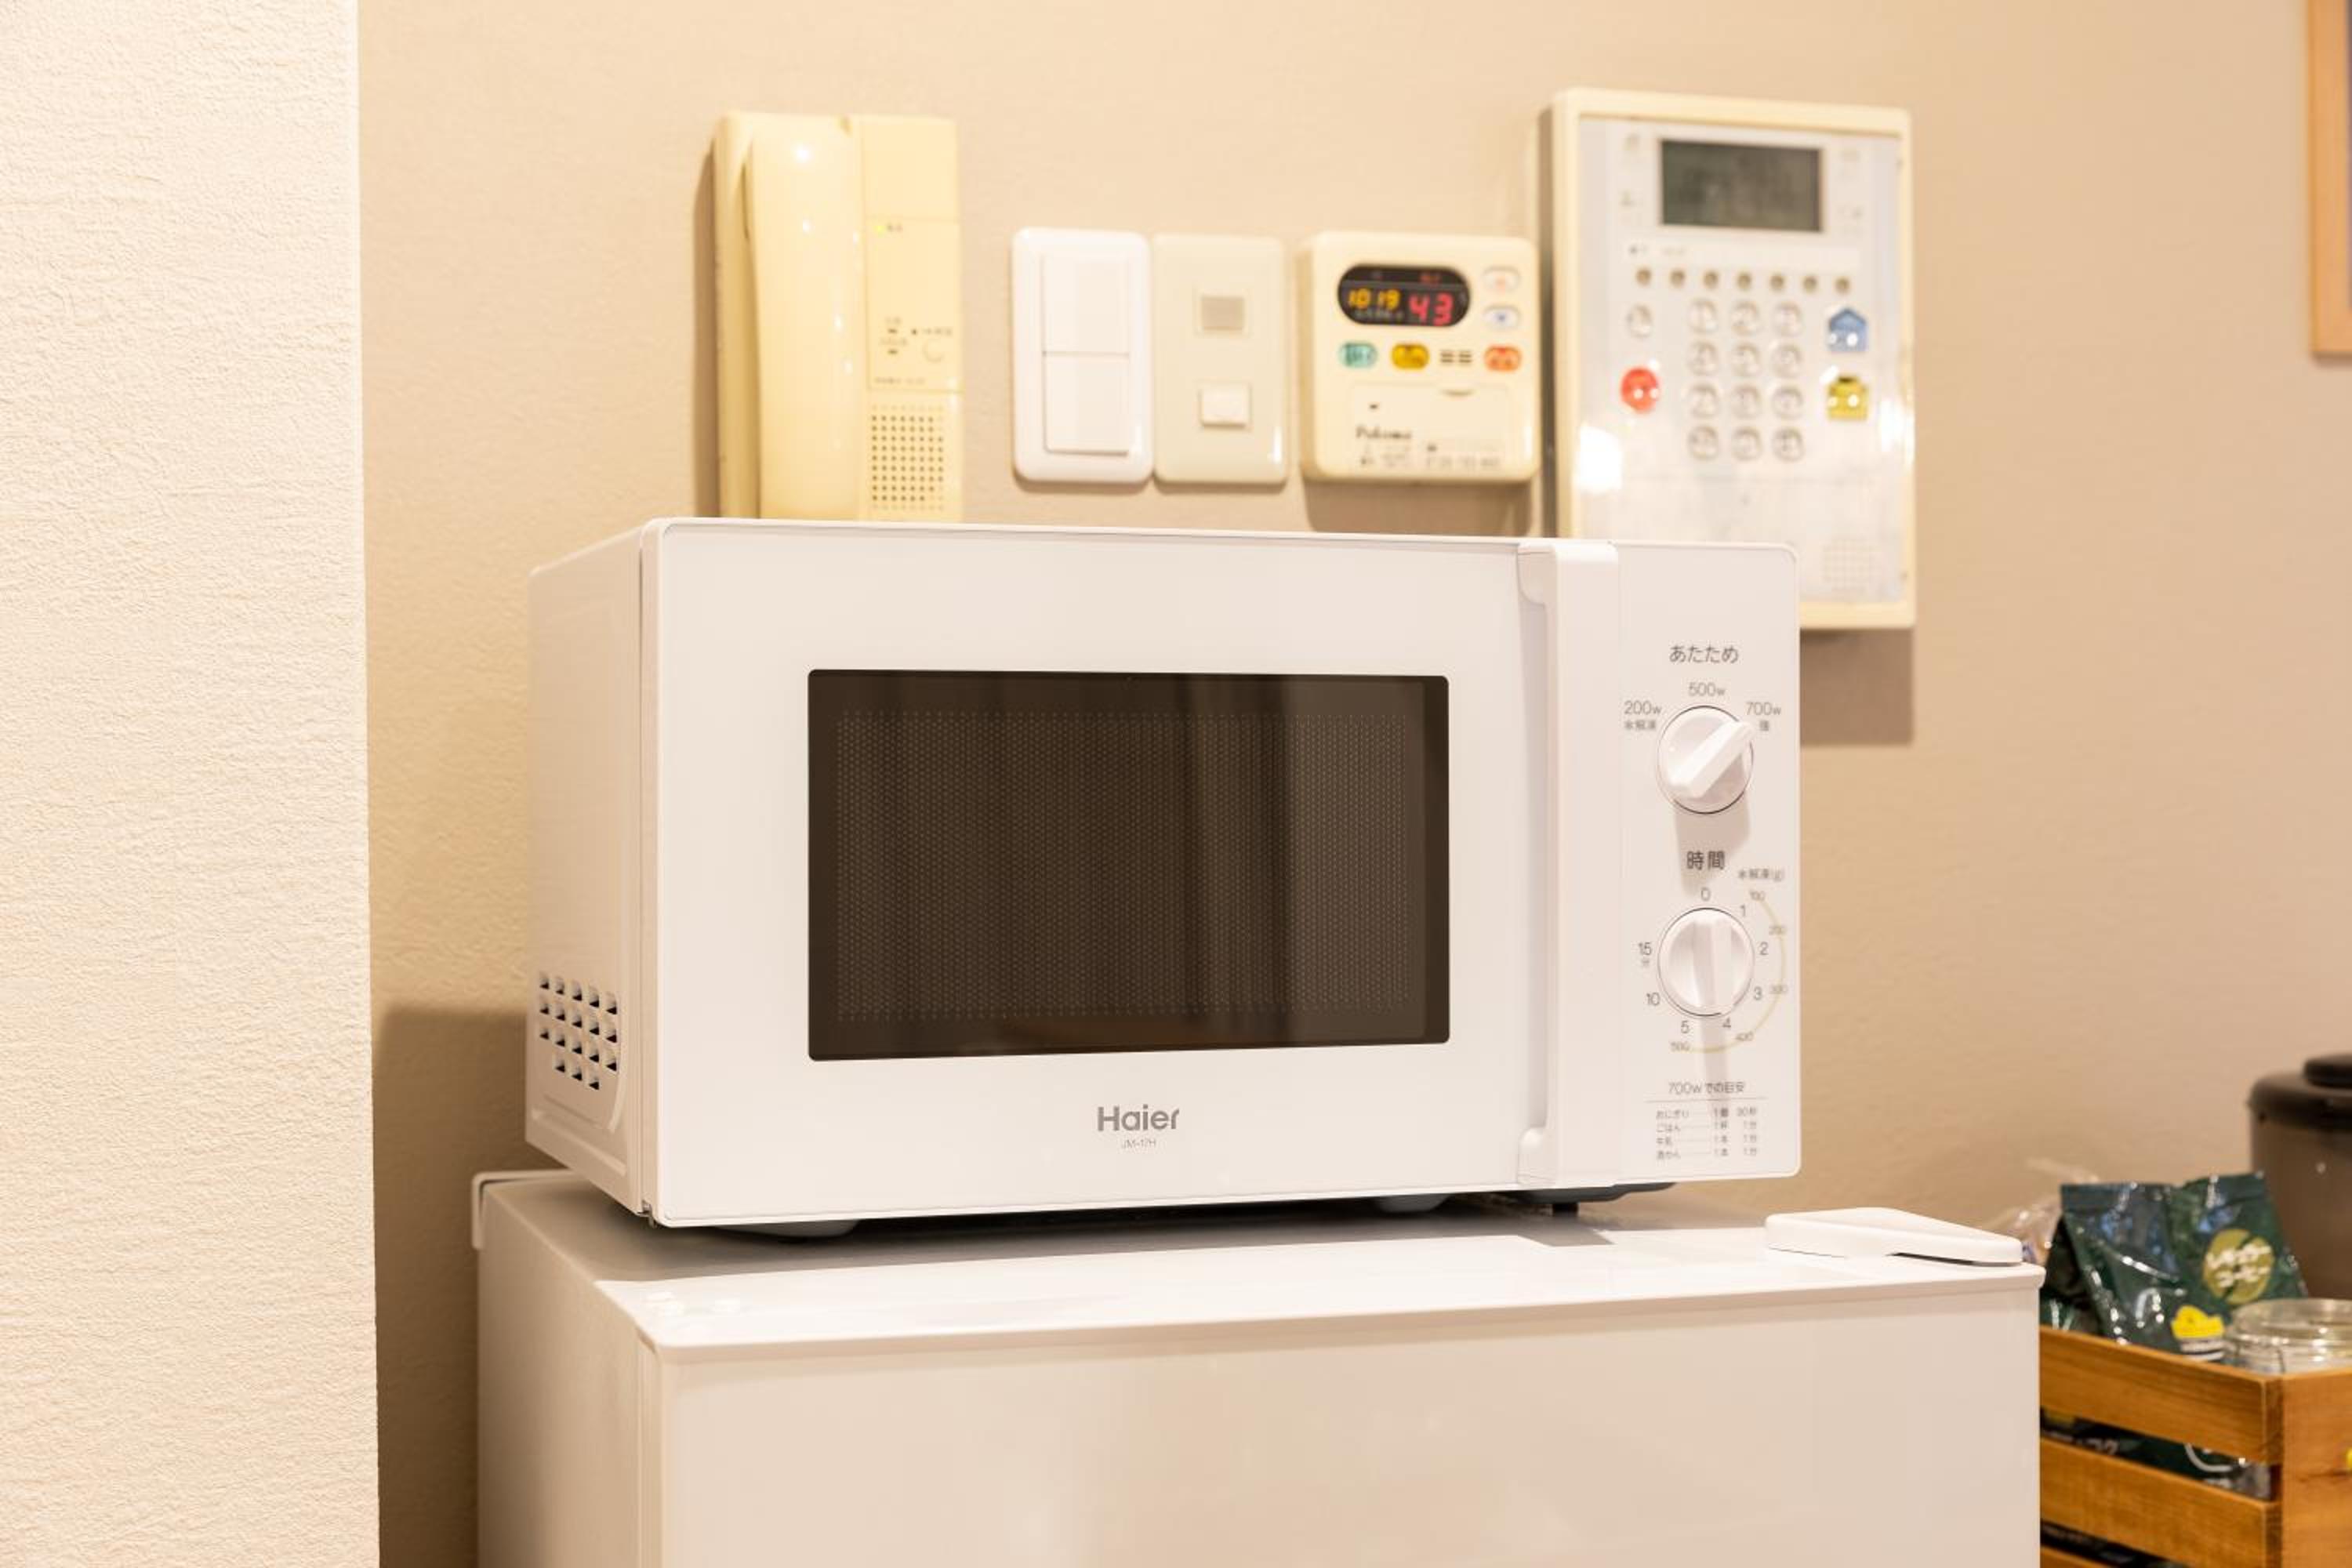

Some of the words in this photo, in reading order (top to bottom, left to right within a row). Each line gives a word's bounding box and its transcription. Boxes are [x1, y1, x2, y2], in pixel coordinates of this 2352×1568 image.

[1408, 291, 1455, 327] 43
[1669, 644, 1739, 664] あたため
[1686, 850, 1725, 870] 時間
[1700, 887, 1711, 902] 0
[1739, 904, 1748, 917] 1
[1638, 942, 1652, 956] 15
[1759, 941, 1769, 956] 2
[1646, 991, 1661, 1007] 10
[1752, 985, 1763, 1000] 3
[1679, 1019, 1691, 1034] 5
[1722, 1017, 1733, 1030] 4
[1098, 1103, 1180, 1131] Haier
